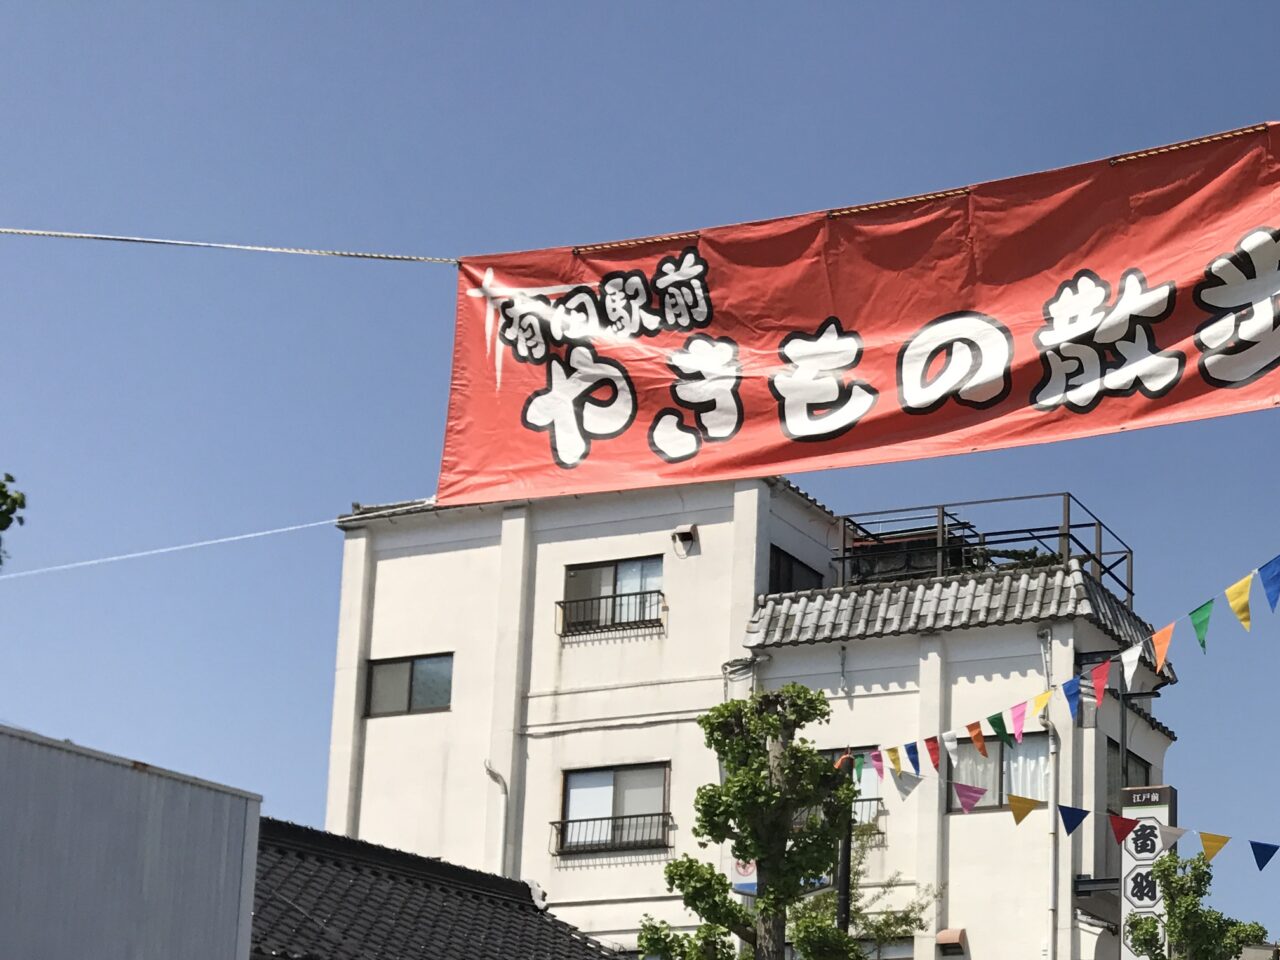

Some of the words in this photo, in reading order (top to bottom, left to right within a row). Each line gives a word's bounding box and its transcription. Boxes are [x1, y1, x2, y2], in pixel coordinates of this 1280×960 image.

[499, 247, 713, 364] 有田駅前
[1132, 793, 1160, 803] 江戸前
